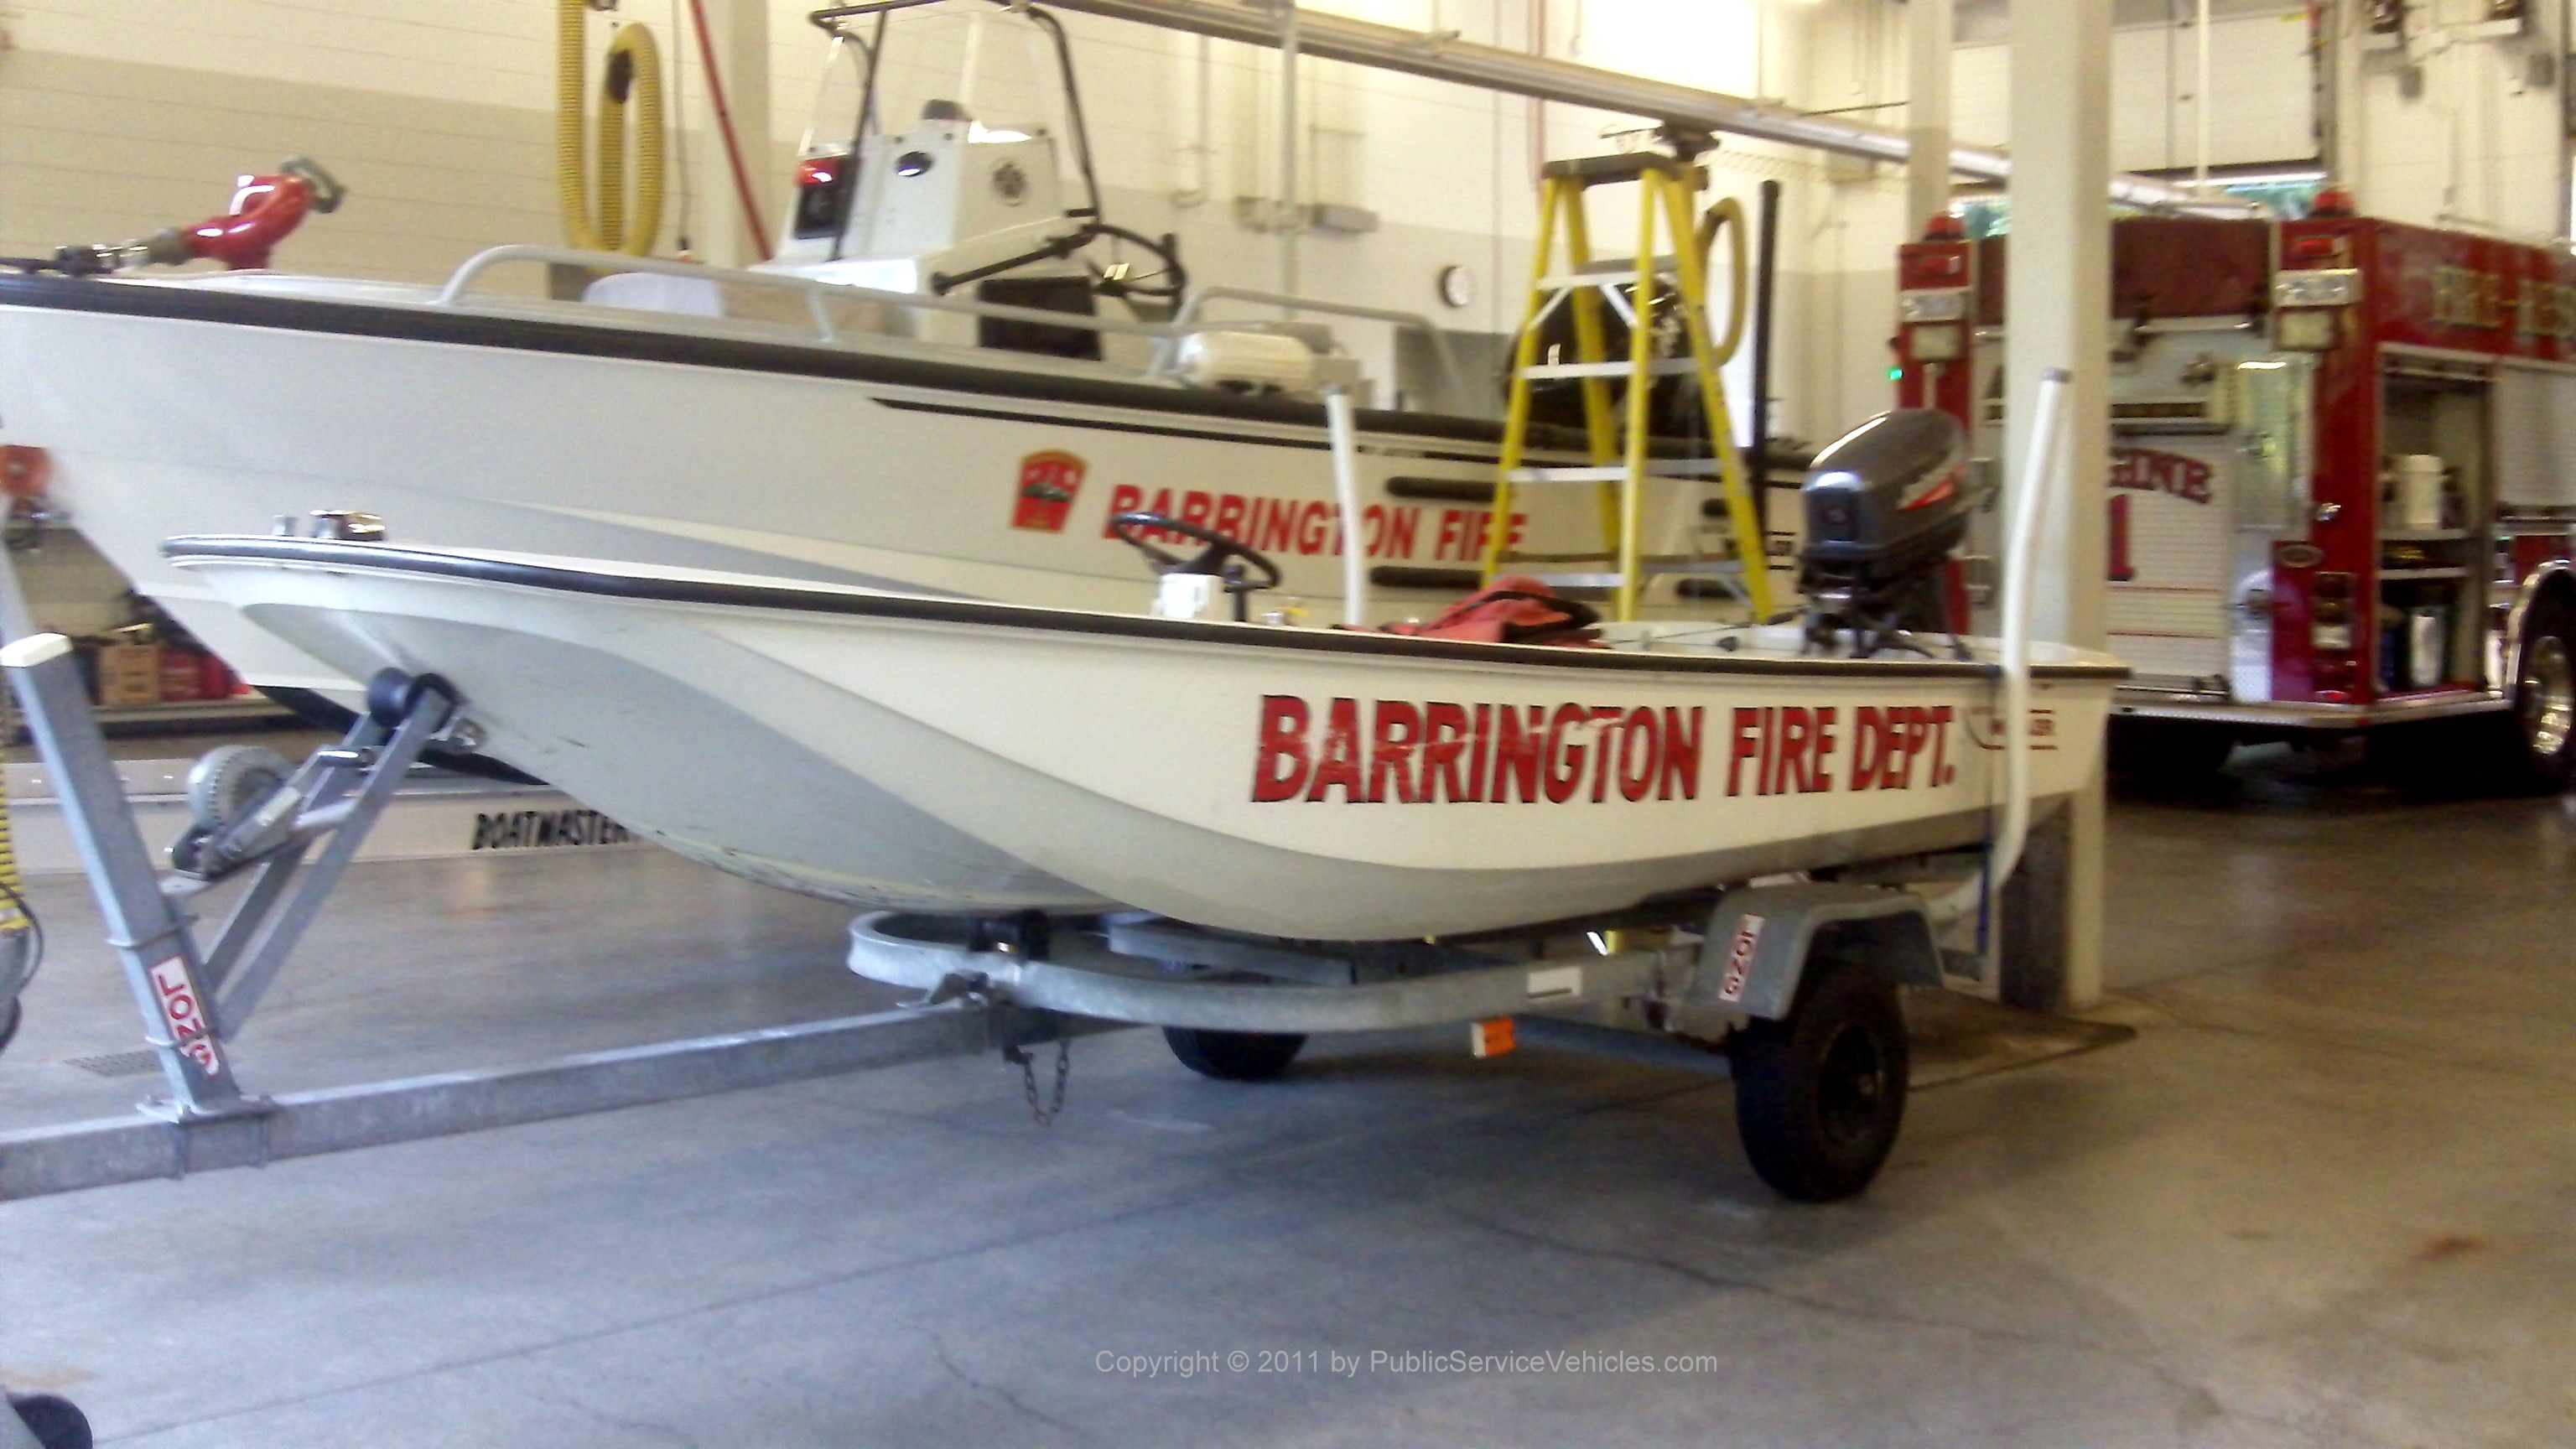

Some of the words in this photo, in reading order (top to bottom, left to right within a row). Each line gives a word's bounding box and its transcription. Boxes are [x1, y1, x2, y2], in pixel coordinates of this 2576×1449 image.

[1250, 694, 1705, 803] BARRINGTON
[1726, 706, 1836, 796] FIRE
[1850, 705, 1955, 791] DEPT.
